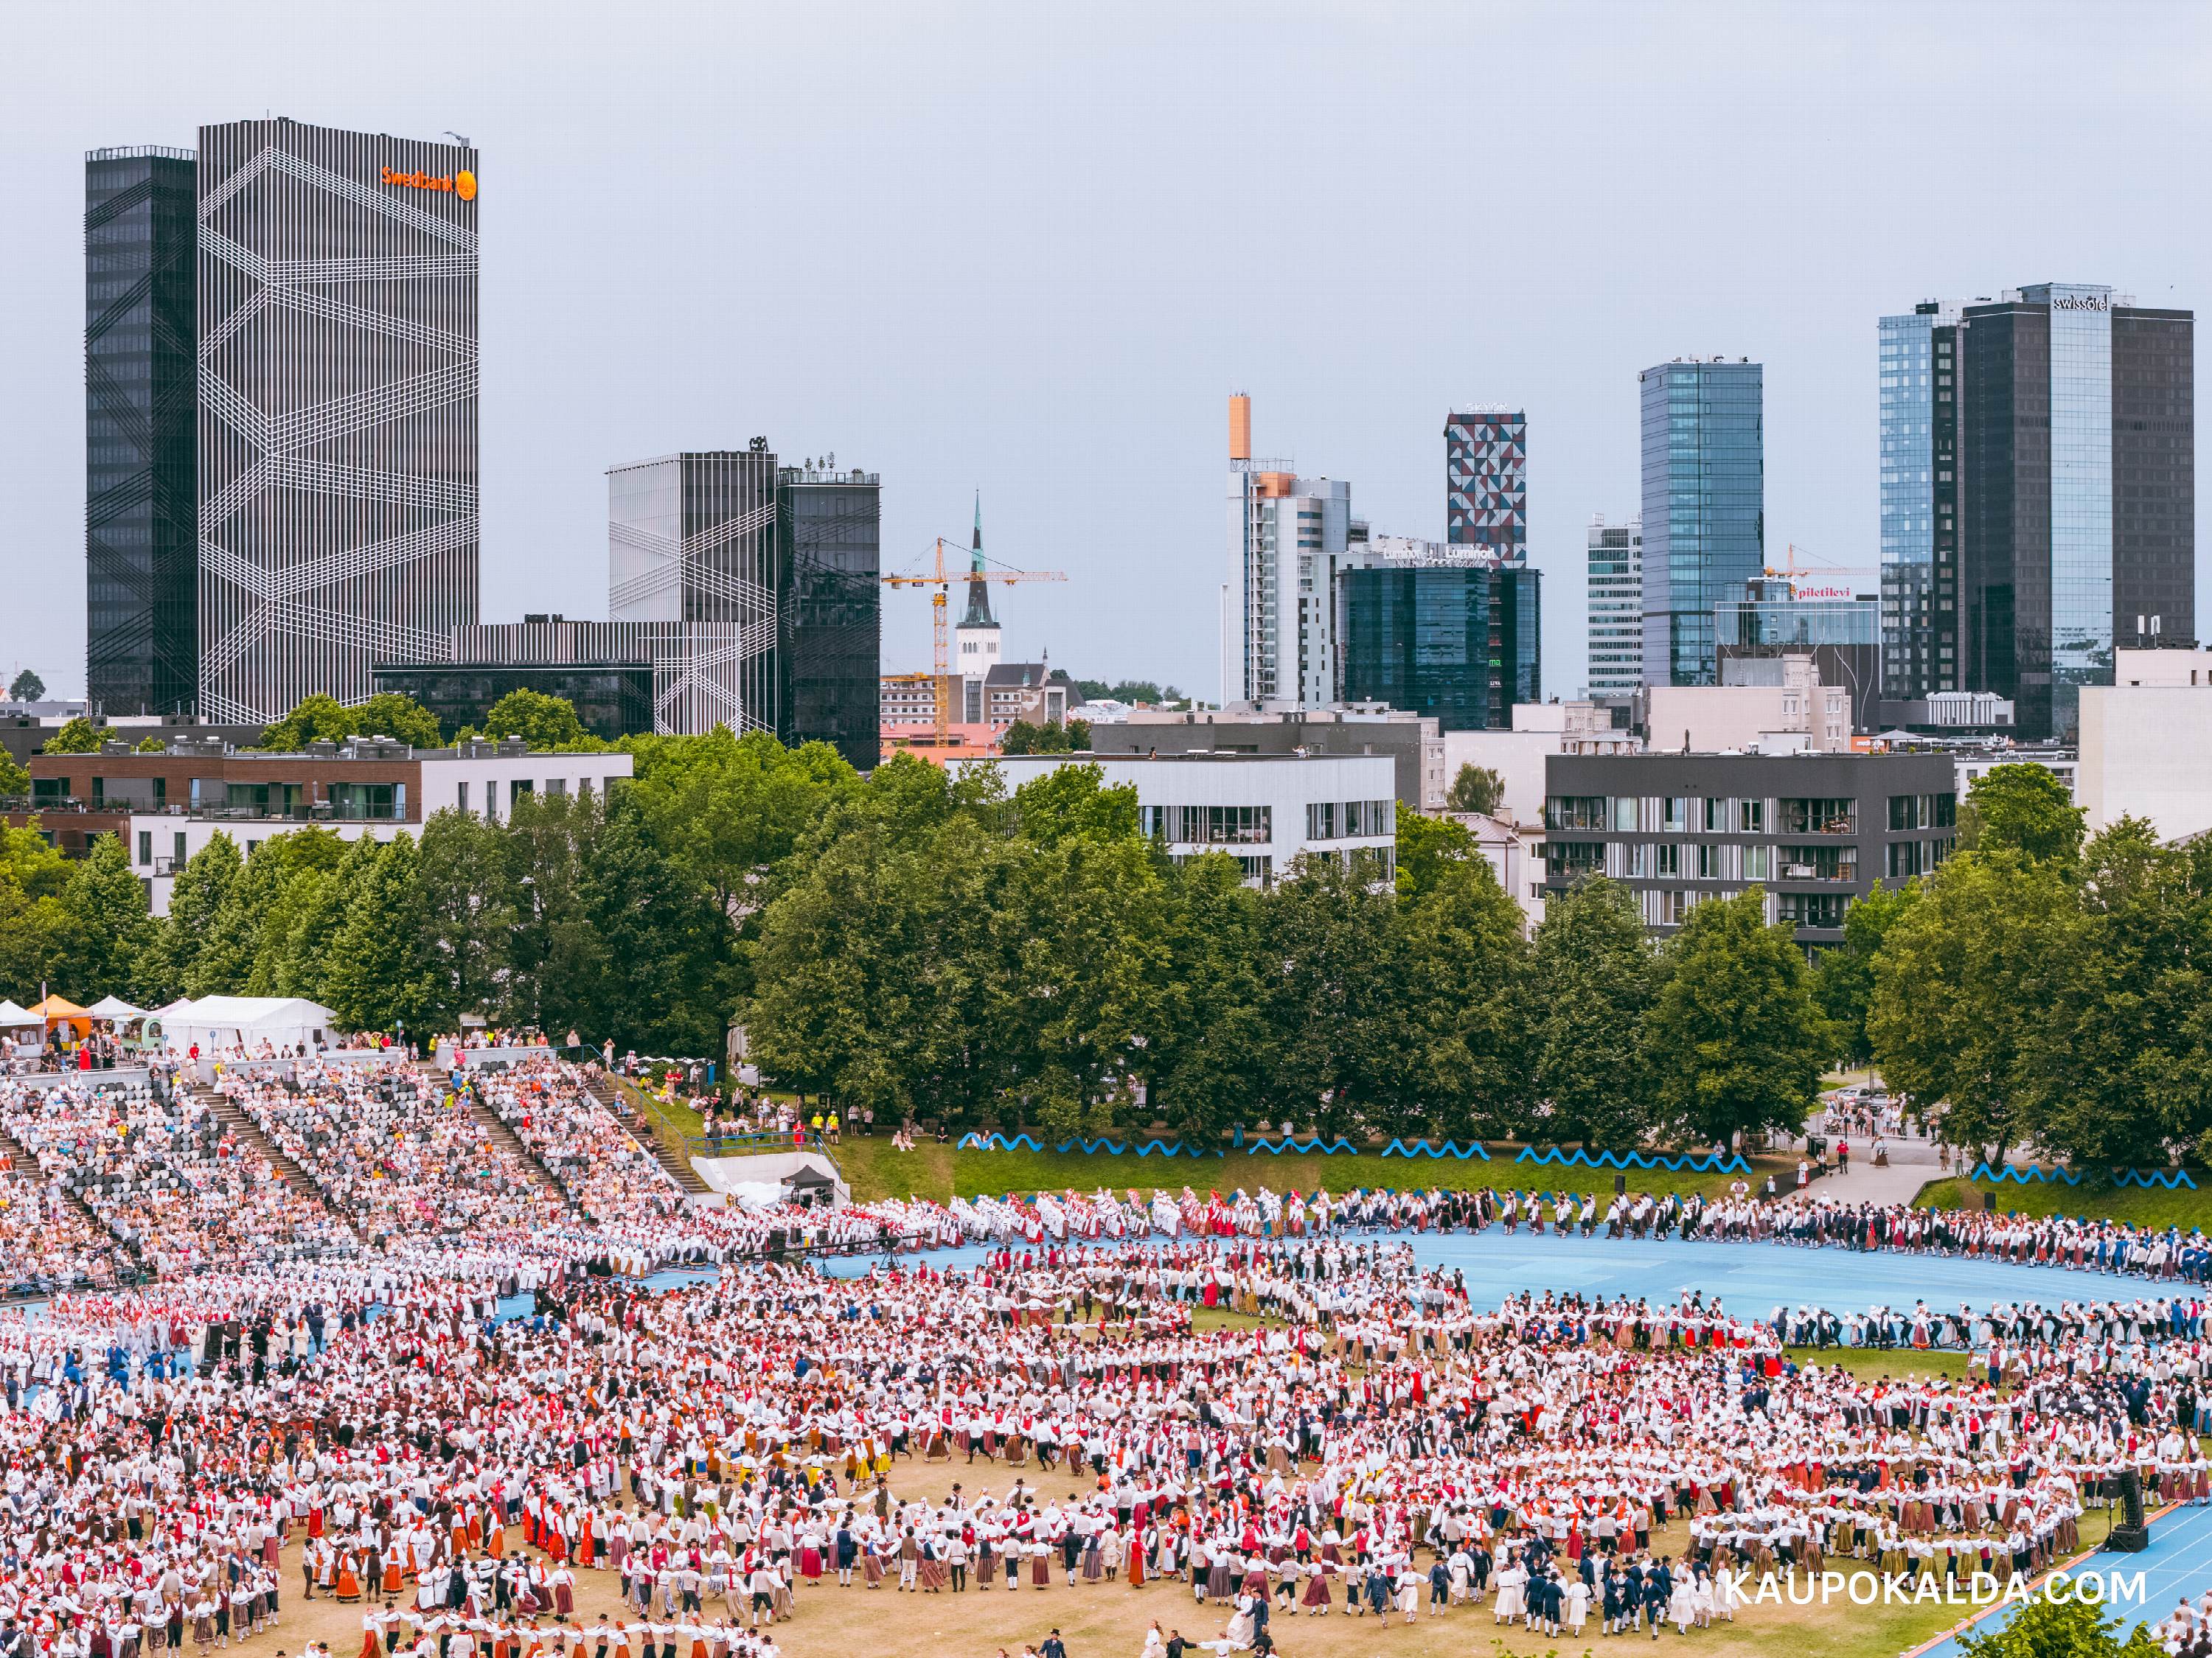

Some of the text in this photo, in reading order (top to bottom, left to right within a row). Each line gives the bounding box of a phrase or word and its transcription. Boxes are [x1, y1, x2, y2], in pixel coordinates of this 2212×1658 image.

[382, 166, 454, 192] Swedbank
[1383, 547, 1422, 560] Luminor
[1798, 587, 1850, 600] piletilevi
